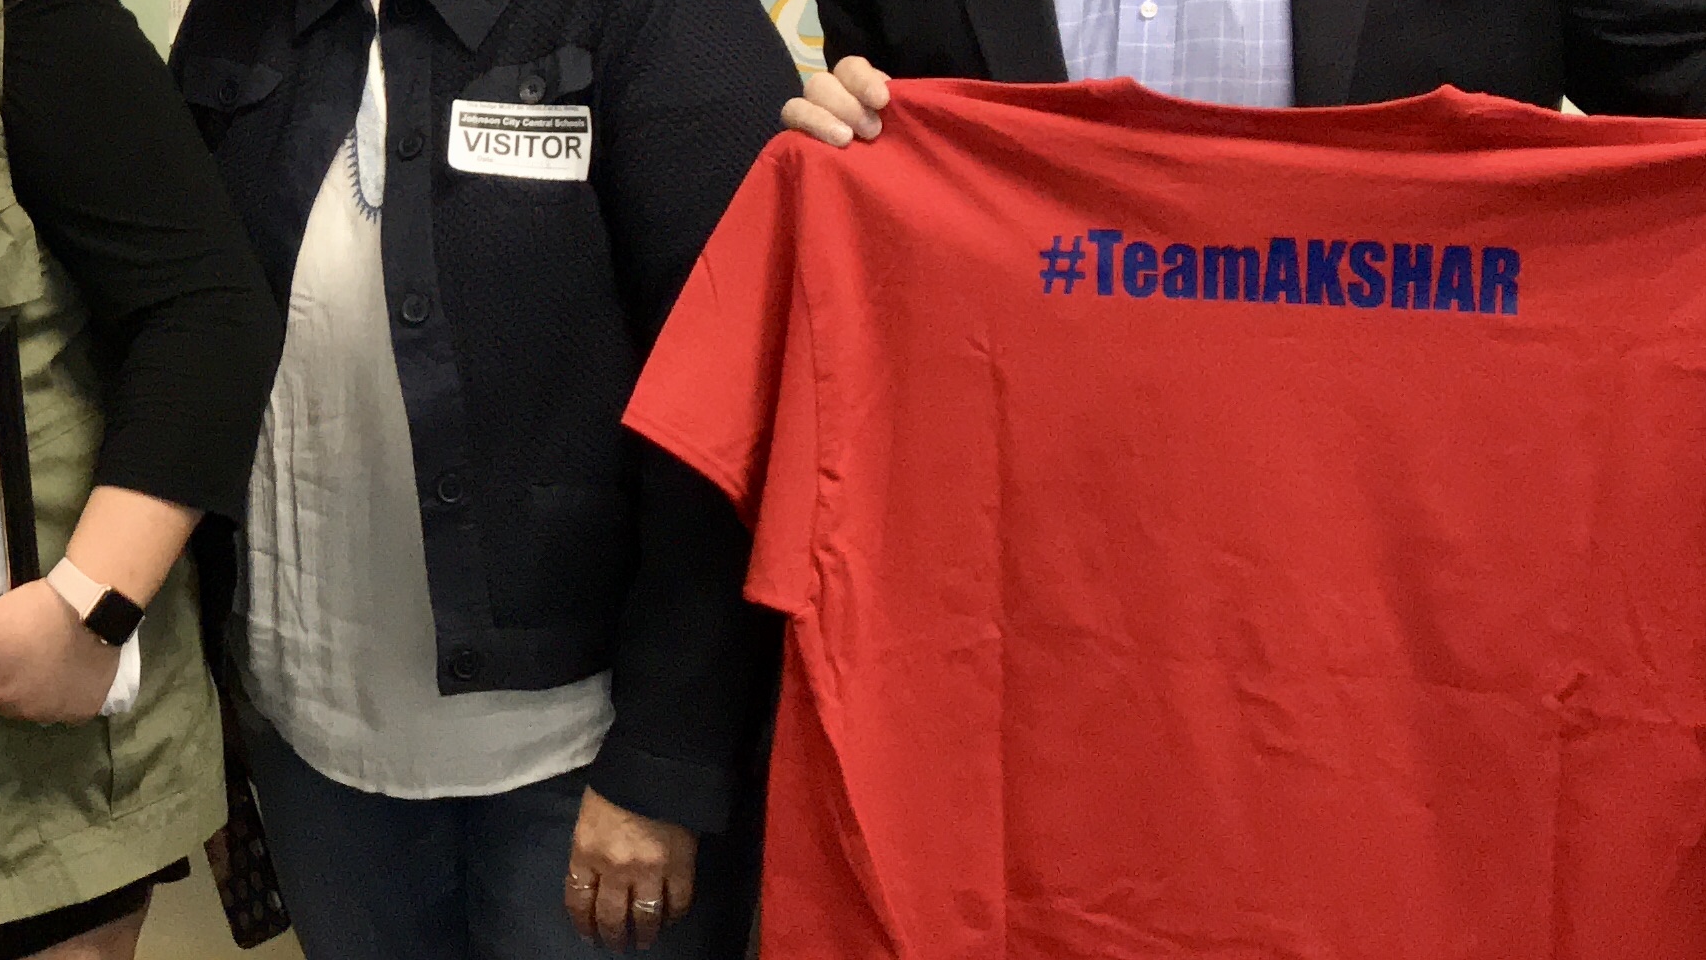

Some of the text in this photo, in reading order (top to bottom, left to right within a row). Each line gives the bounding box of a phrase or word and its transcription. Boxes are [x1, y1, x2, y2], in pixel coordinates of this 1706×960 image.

[461, 113, 501, 126] Johnson
[502, 116, 521, 128] City
[463, 130, 582, 159] VISITOR
[1039, 228, 1522, 316] #TeamAKSHAR
